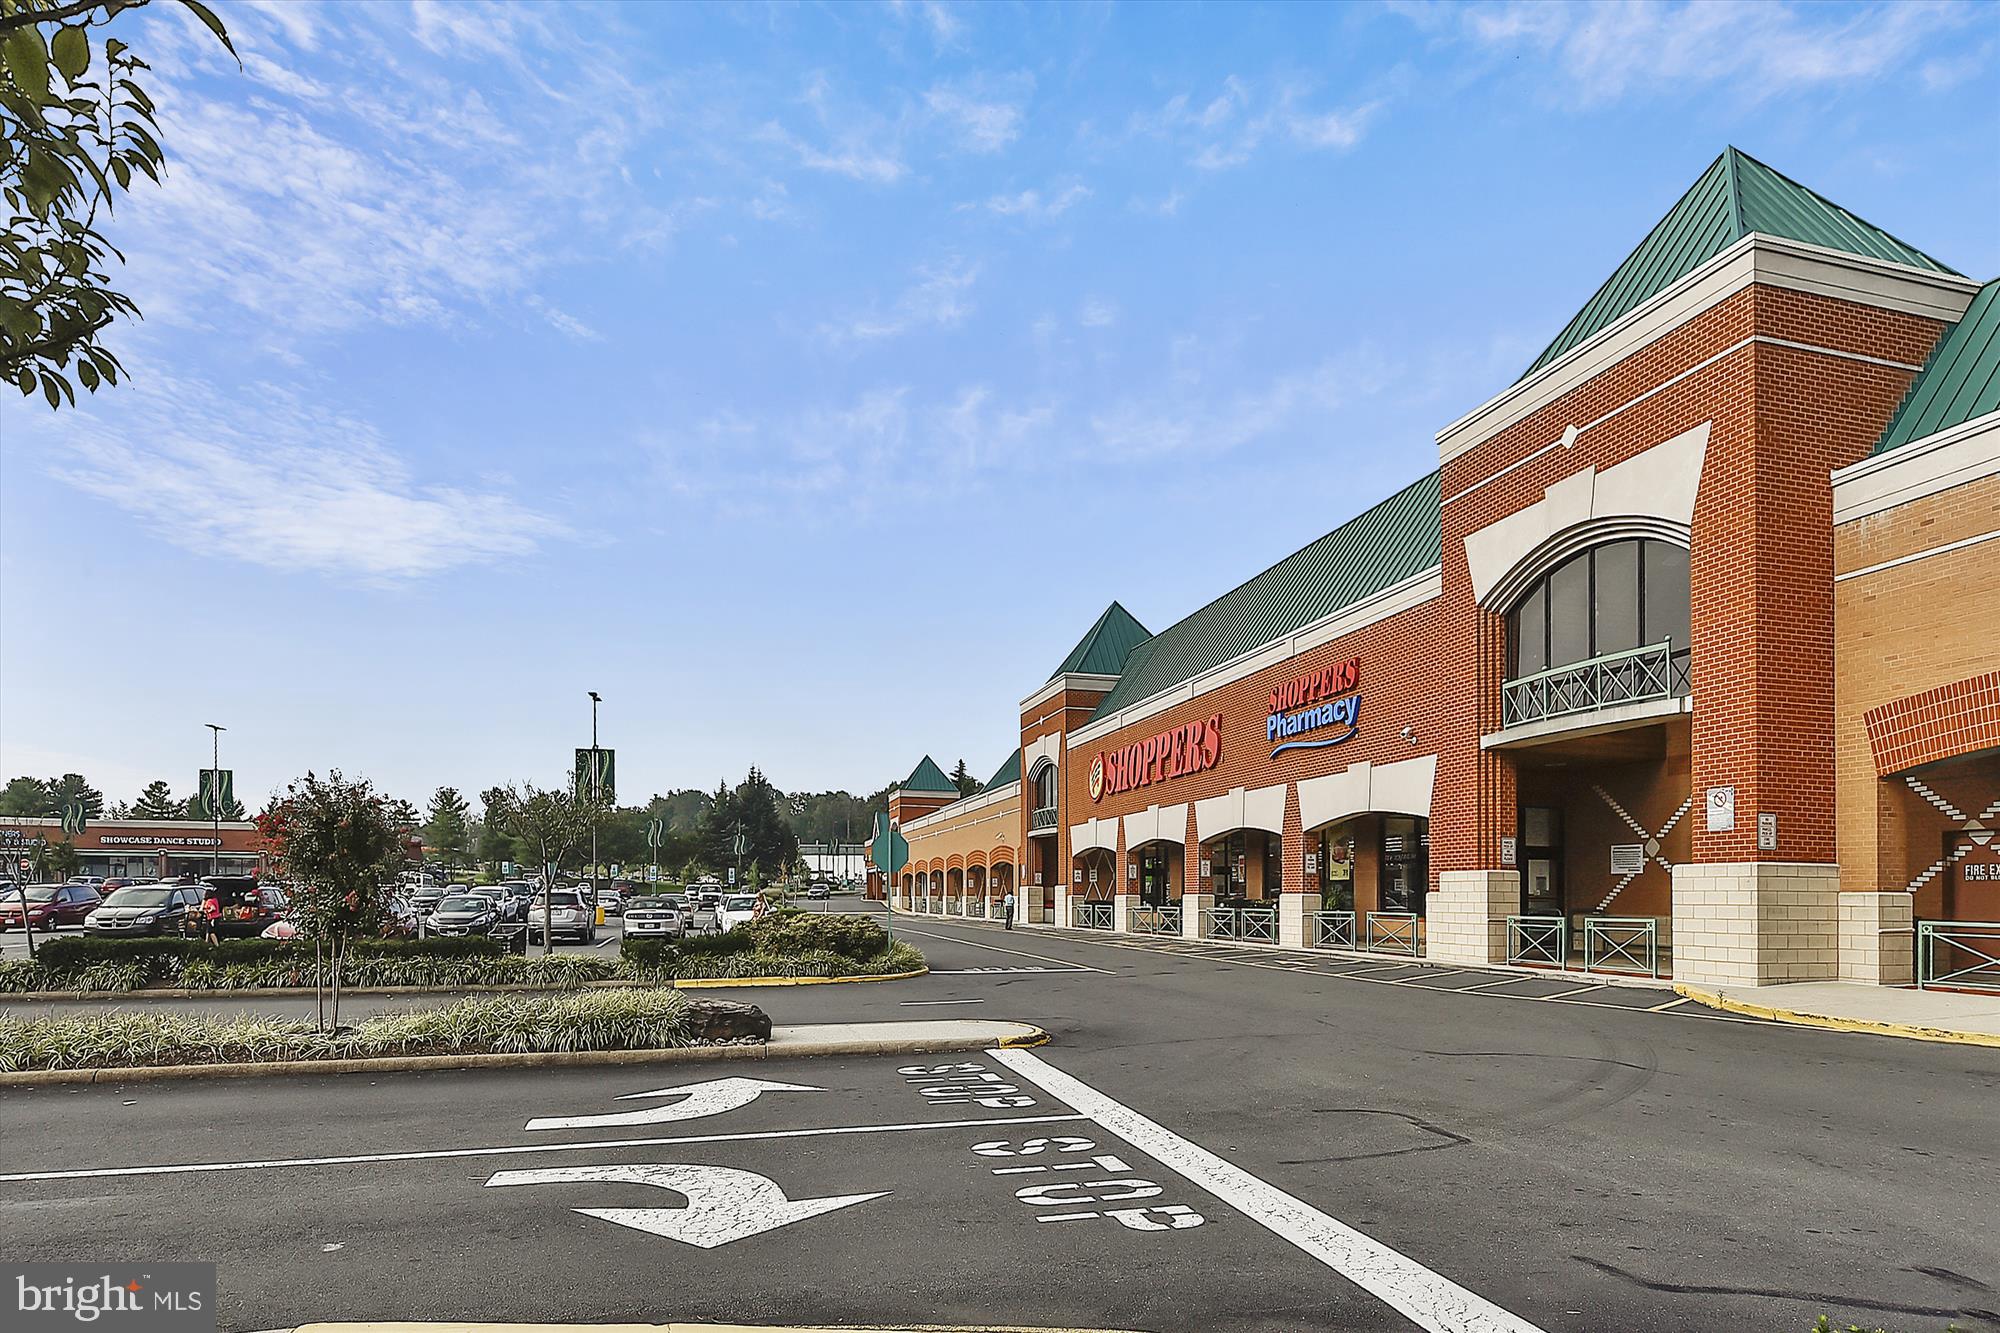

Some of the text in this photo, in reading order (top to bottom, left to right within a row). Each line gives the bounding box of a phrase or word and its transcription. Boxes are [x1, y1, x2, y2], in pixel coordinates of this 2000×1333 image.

[1268, 656, 1360, 715] SHOPPERS
[1266, 694, 1361, 742] Pharmacy
[1105, 712, 1223, 795] SHOPPERS
[100, 836, 152, 844] SHOWCASE
[153, 836, 185, 845] DANCE
[1965, 864, 1986, 875] FIRE
[896, 1061, 1038, 1109] STOP
[970, 1135, 1206, 1232] STOP
